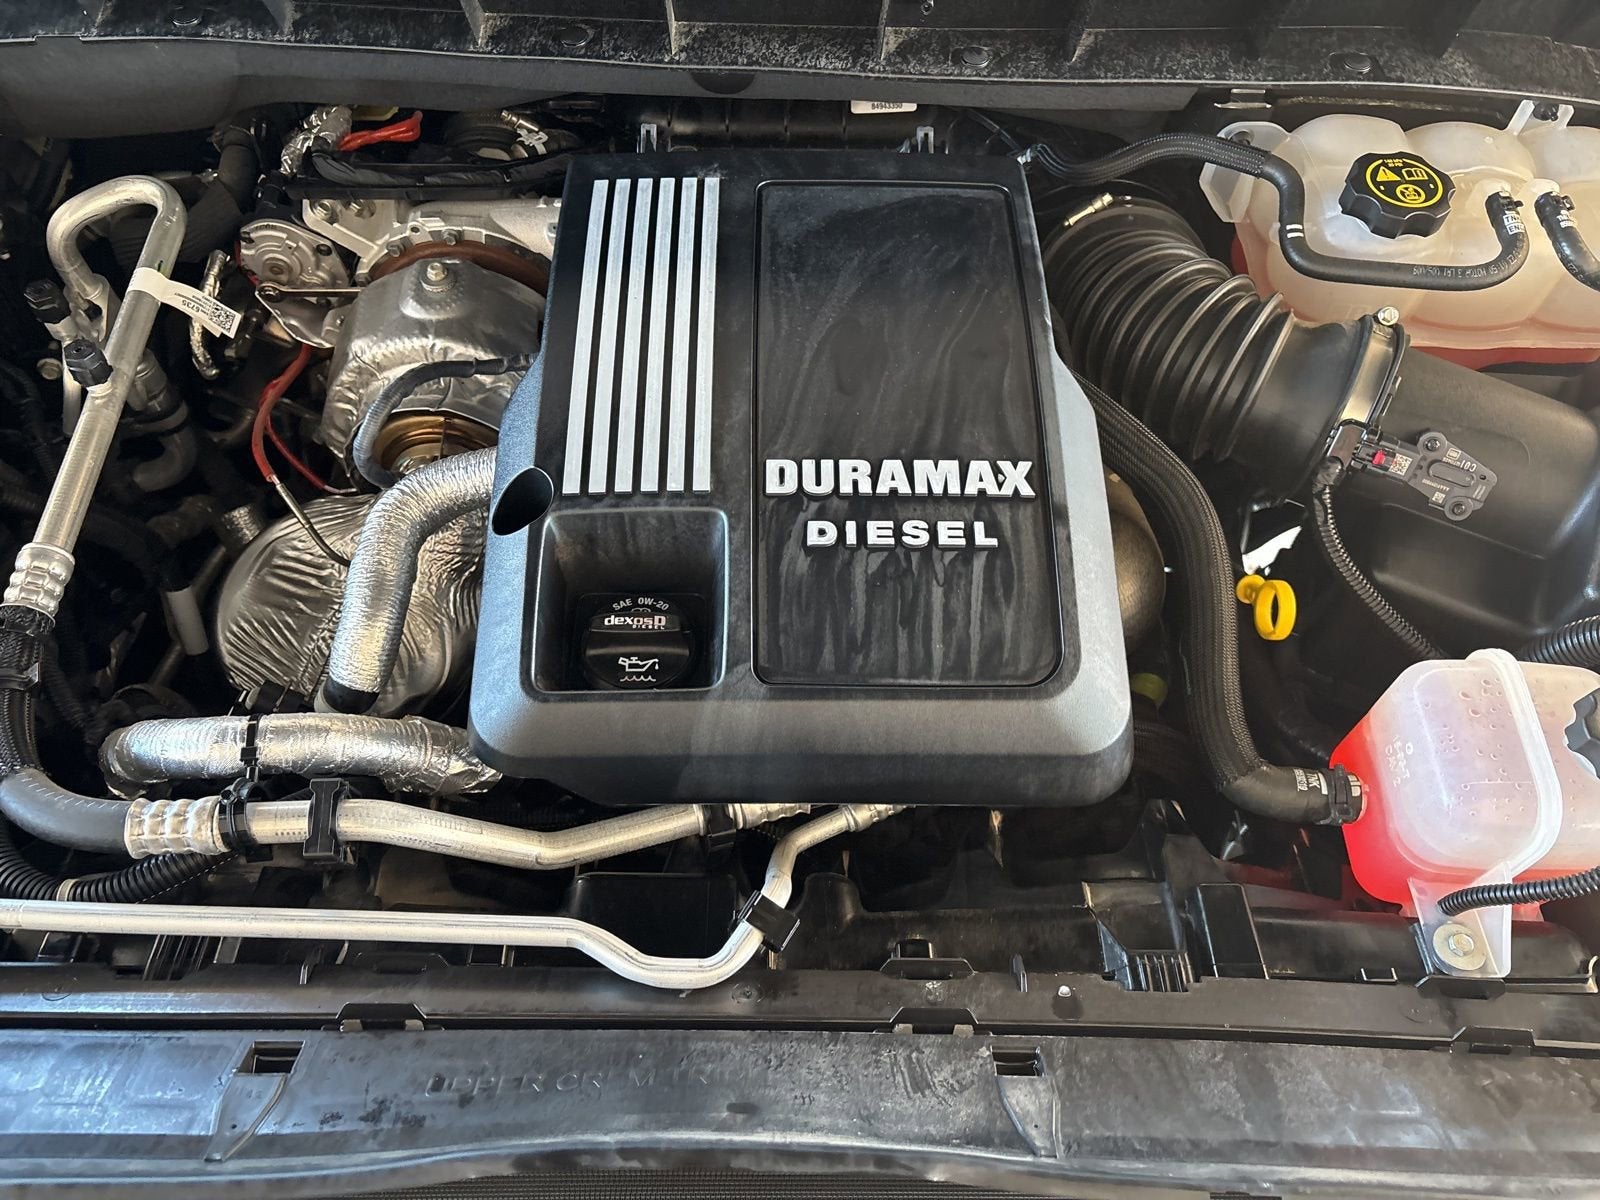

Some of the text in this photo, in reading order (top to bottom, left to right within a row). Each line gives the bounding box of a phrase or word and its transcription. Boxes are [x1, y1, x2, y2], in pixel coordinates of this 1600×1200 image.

[764, 459, 1036, 498] DURAMAX
[806, 520, 998, 548] DIESEL
[612, 597, 670, 611] SAE 0W-20
[1307, 773, 1320, 789] TNK
